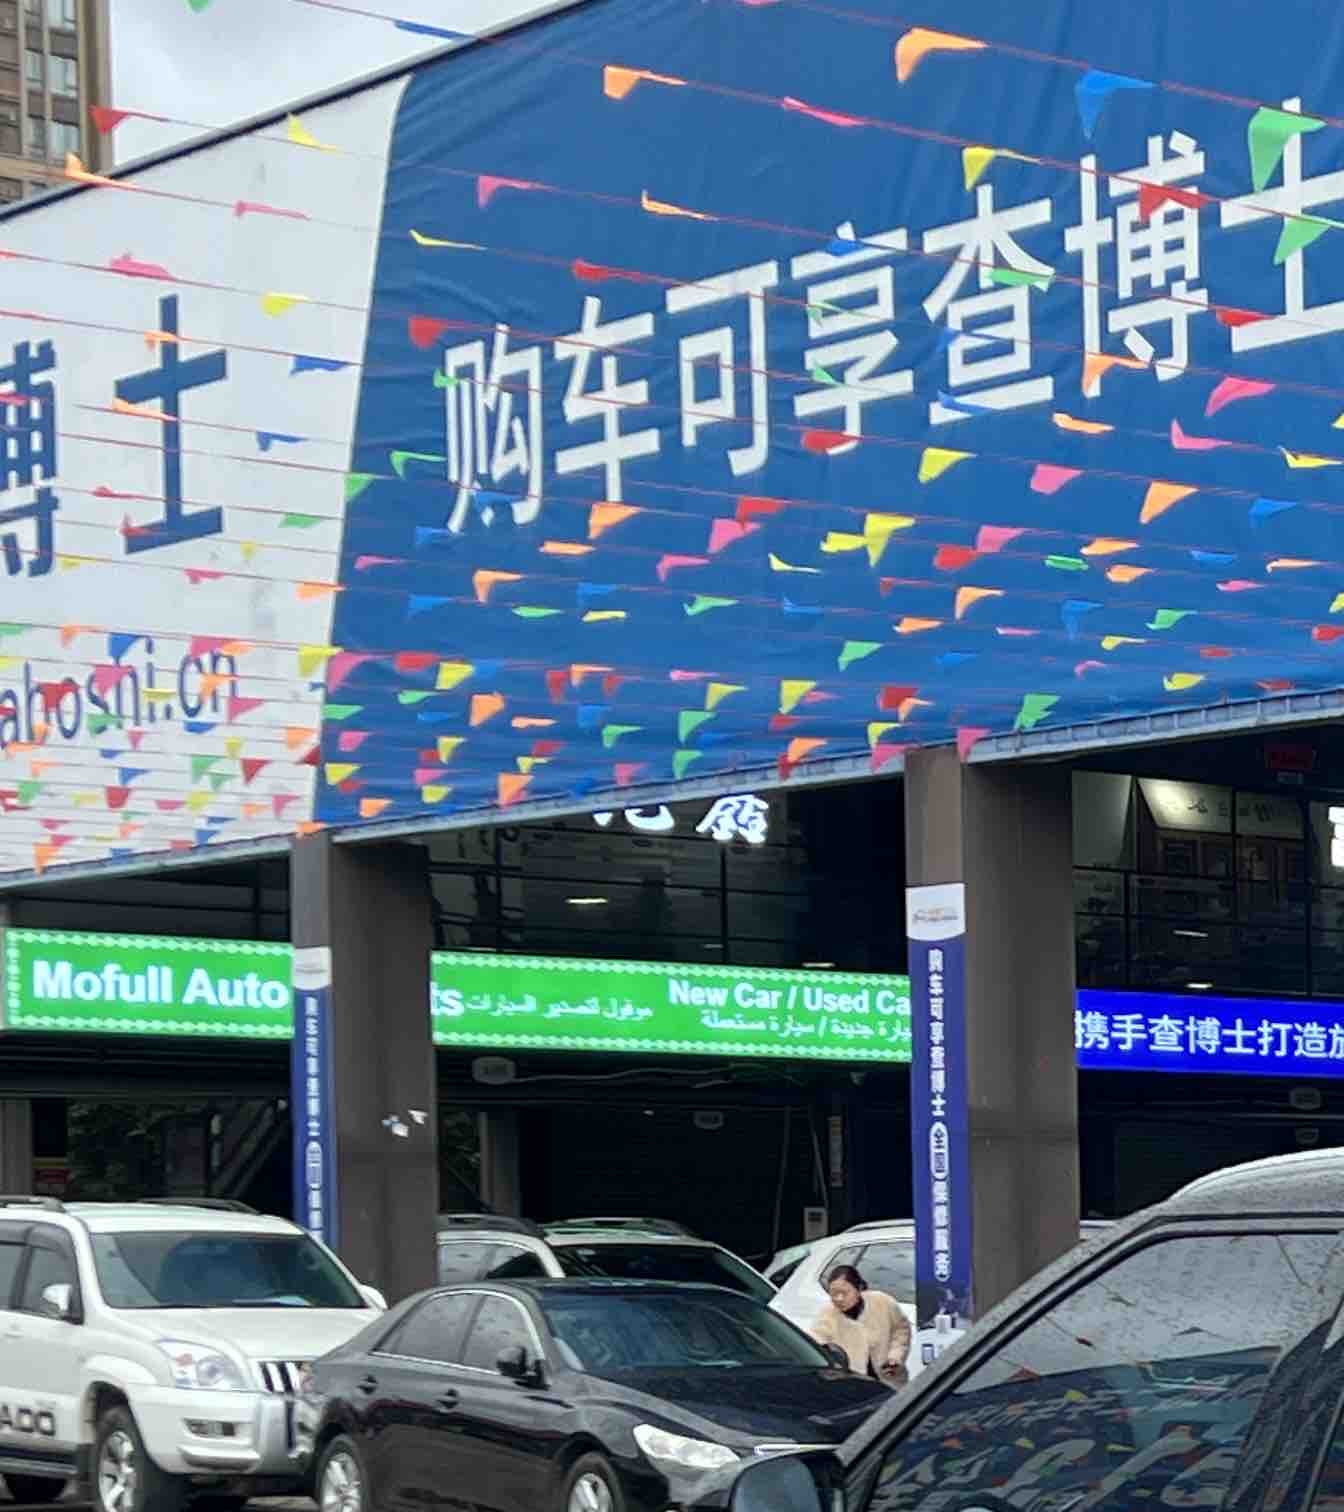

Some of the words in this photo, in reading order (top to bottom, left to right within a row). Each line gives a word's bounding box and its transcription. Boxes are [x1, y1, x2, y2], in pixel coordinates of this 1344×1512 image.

[32, 959, 172, 1004] Mofull
[182, 967, 291, 1009] Auto
[668, 978, 728, 1006] New
[734, 983, 782, 1009] Car
[803, 987, 869, 1014] Used
